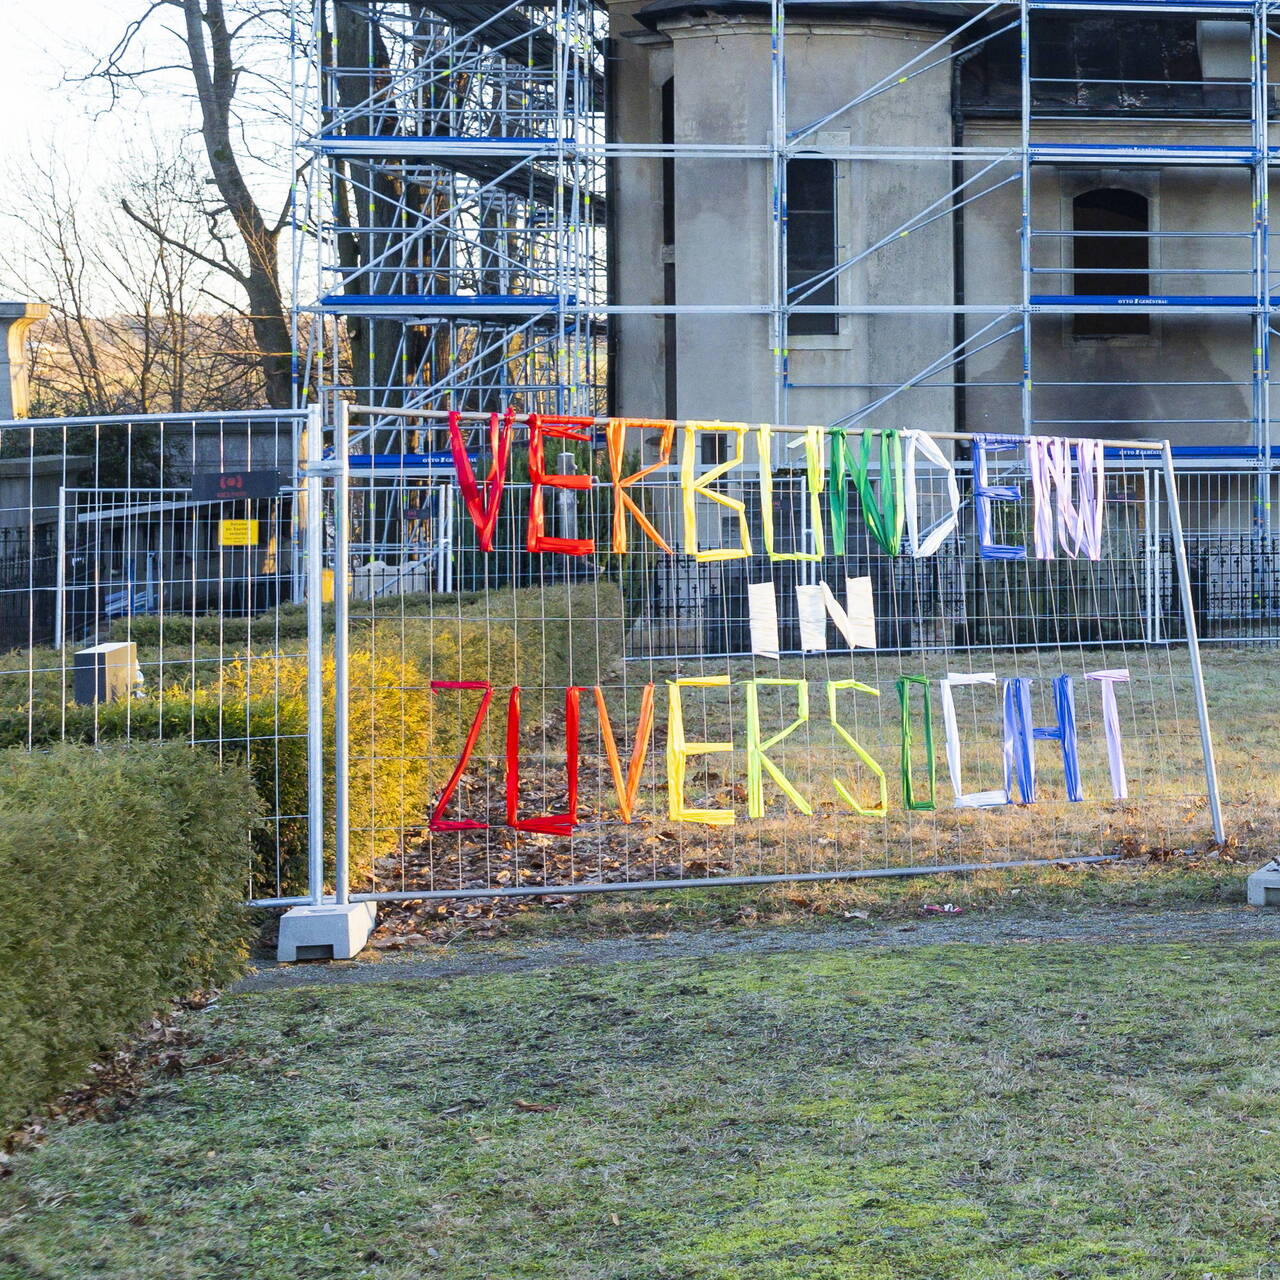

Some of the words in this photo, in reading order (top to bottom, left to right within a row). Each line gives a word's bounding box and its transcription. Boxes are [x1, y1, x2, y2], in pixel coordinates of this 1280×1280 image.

[448, 407, 1104, 563] VERBUNDEN
[747, 575, 878, 660] IN
[429, 668, 1131, 836] ZUVERSICHT
